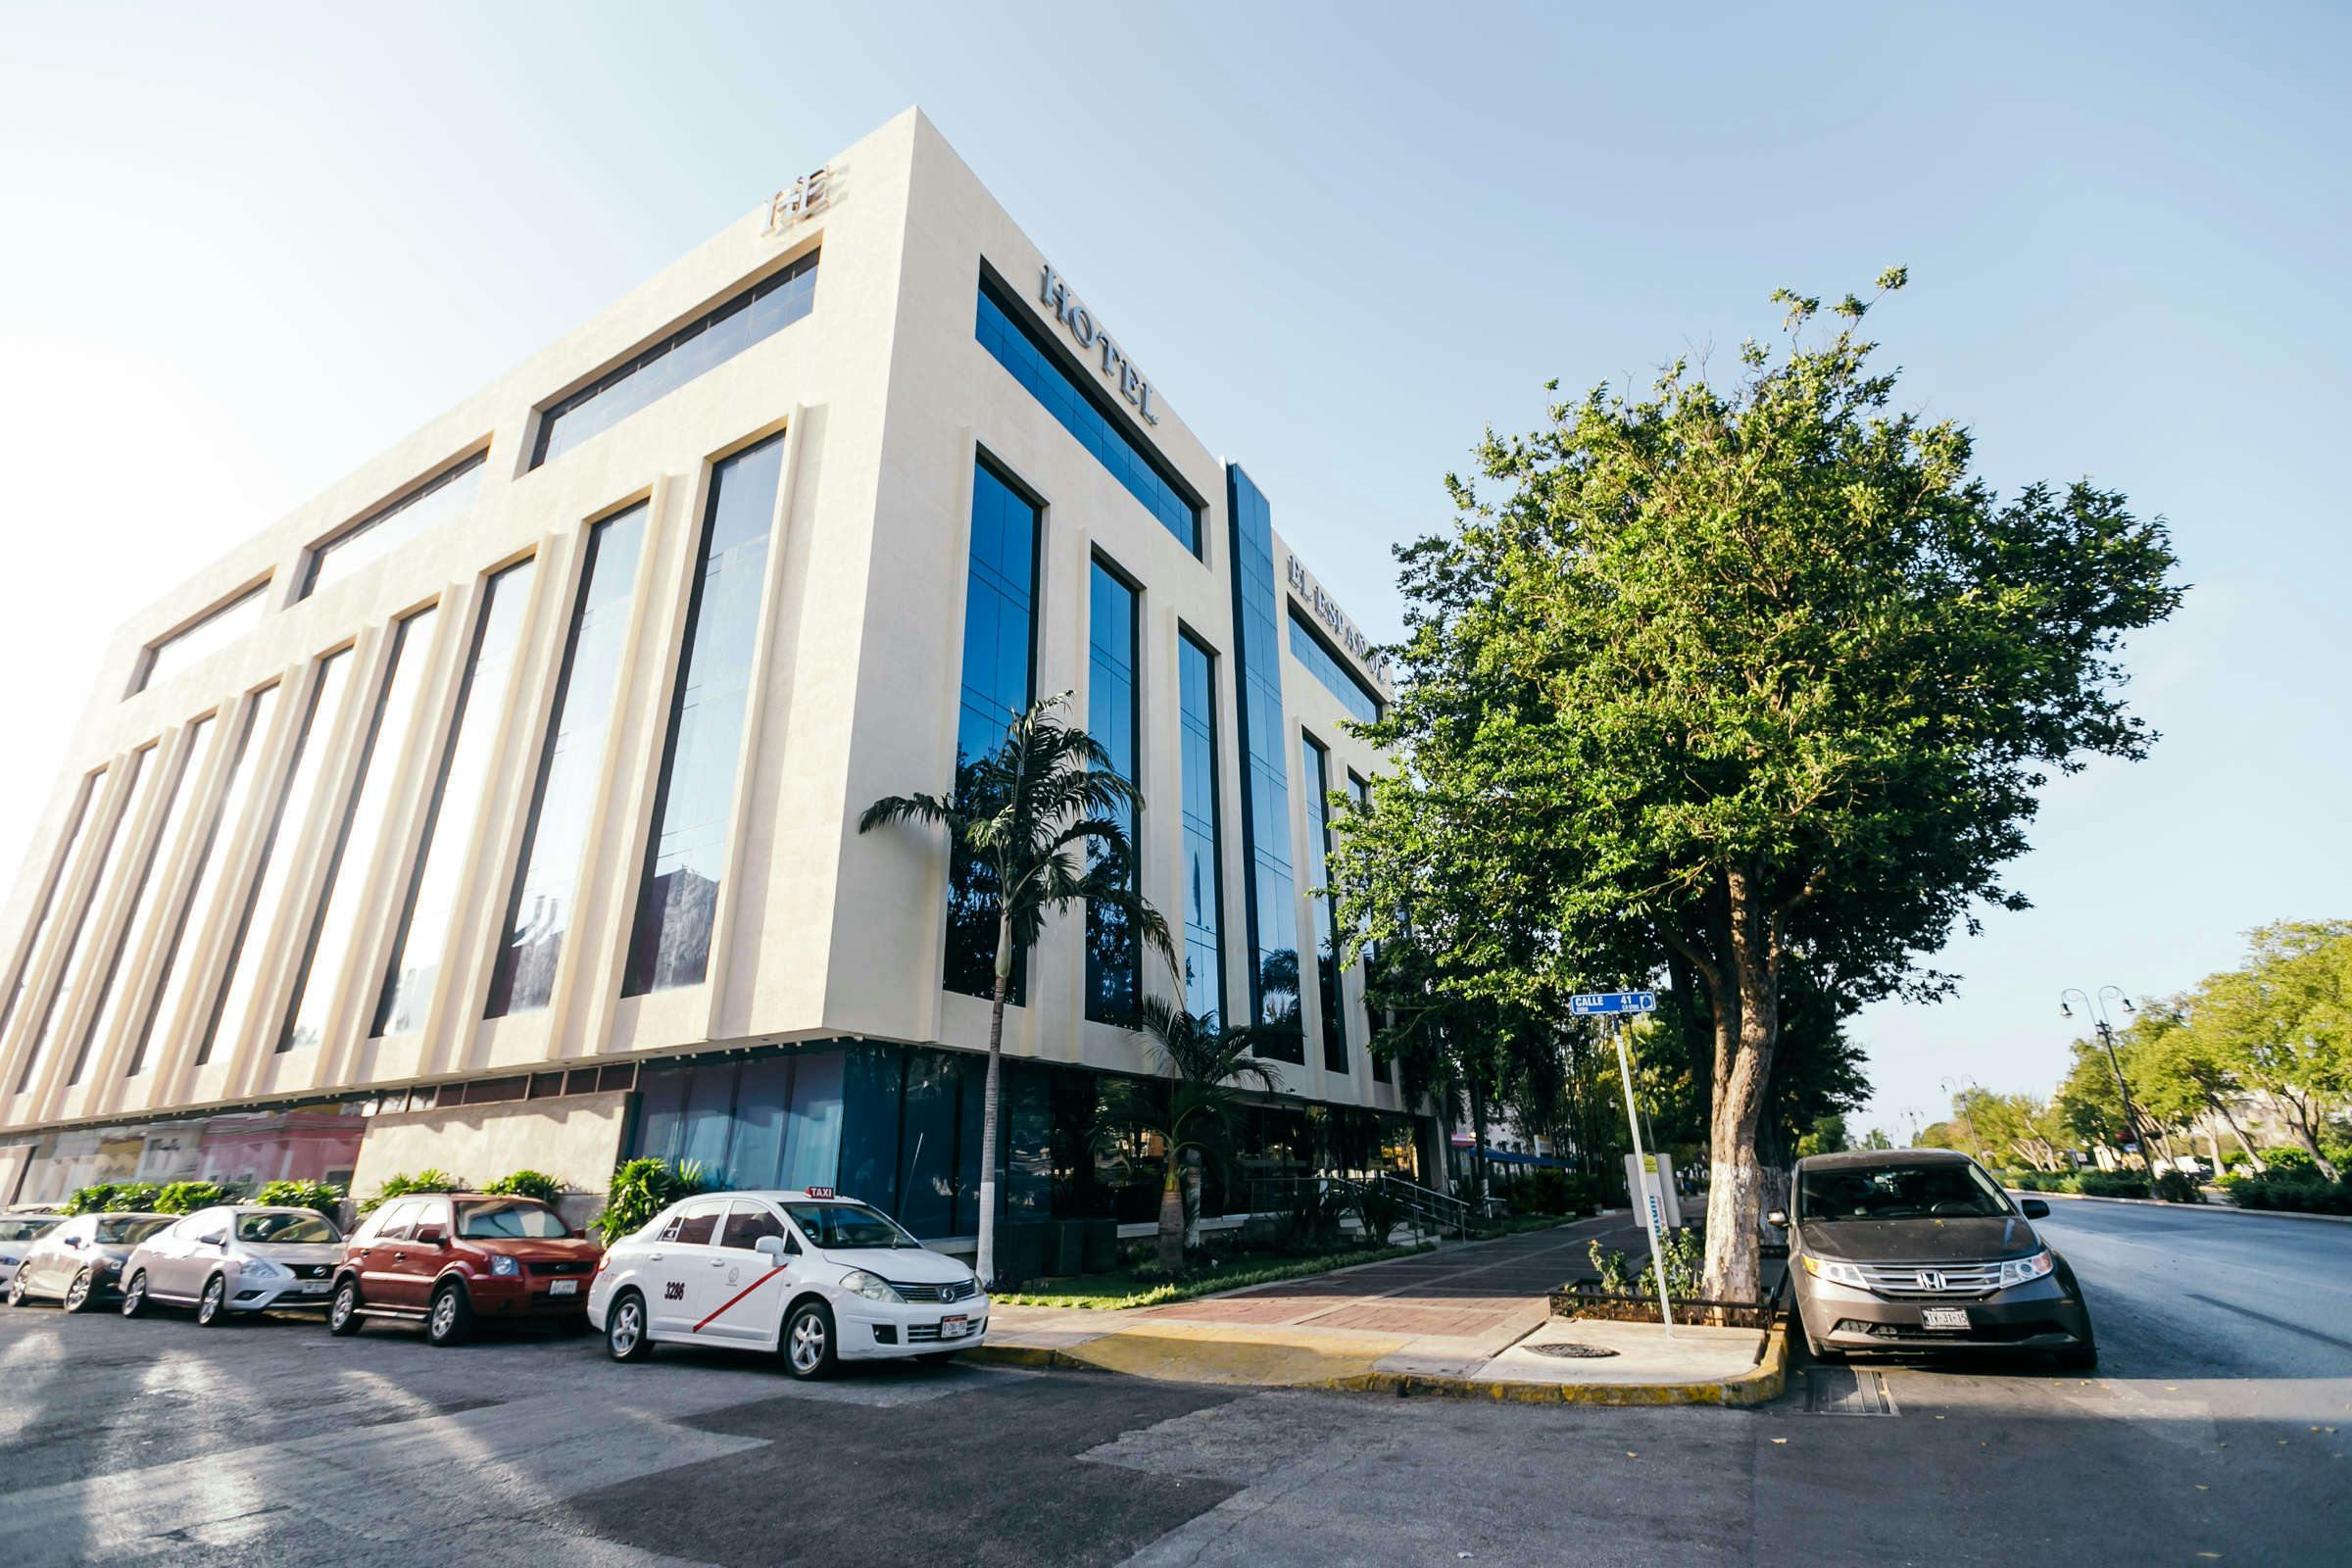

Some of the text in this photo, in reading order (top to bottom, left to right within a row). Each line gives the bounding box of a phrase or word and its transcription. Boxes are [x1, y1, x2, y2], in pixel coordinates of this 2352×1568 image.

[1040, 264, 1159, 426] HOTEL
[1288, 555, 1312, 603] EL
[1575, 997, 1604, 1006] CALLE
[810, 1188, 832, 1198] TAXI
